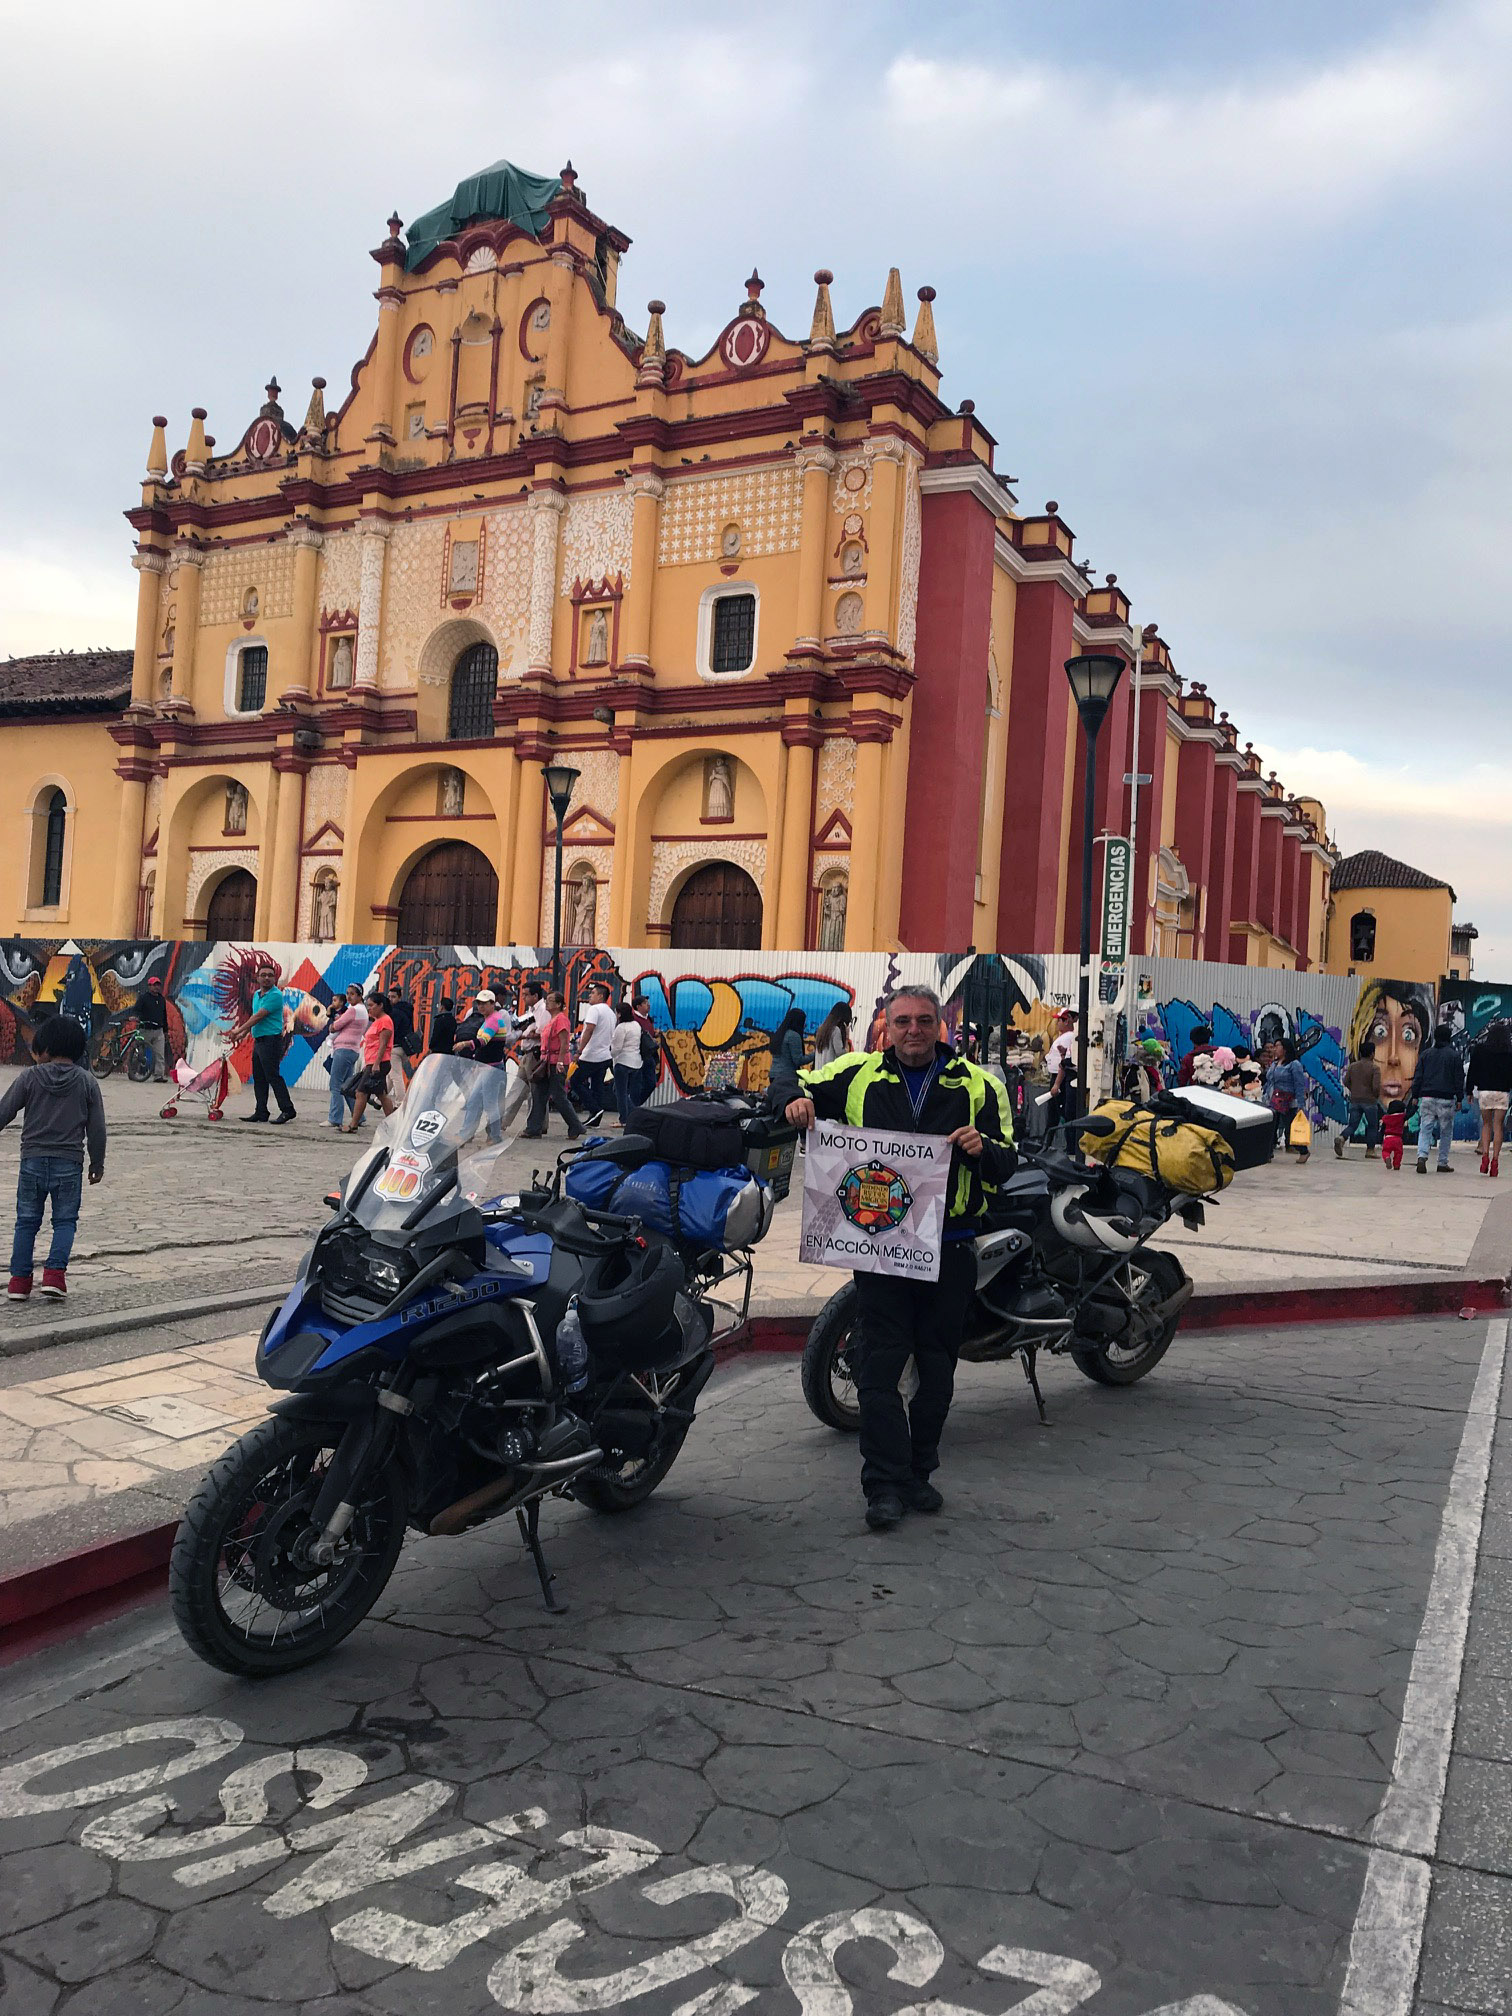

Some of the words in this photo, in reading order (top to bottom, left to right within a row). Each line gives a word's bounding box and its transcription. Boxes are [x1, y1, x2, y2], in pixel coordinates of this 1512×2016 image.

[1106, 844, 1126, 956] EMERGENCIAS
[415, 1119, 440, 1135] 122
[820, 1132, 868, 1152] MOTO
[872, 1140, 934, 1159] TURISTA
[871, 1162, 880, 1170] N
[806, 1235, 823, 1248] EN
[825, 1238, 880, 1257] ACCIÓN
[883, 1244, 934, 1264] MÉXICO
[981, 1246, 1006, 1262] GS
[400, 1280, 501, 1325] R1200
[0, 1714, 1252, 2016] SCENSO
